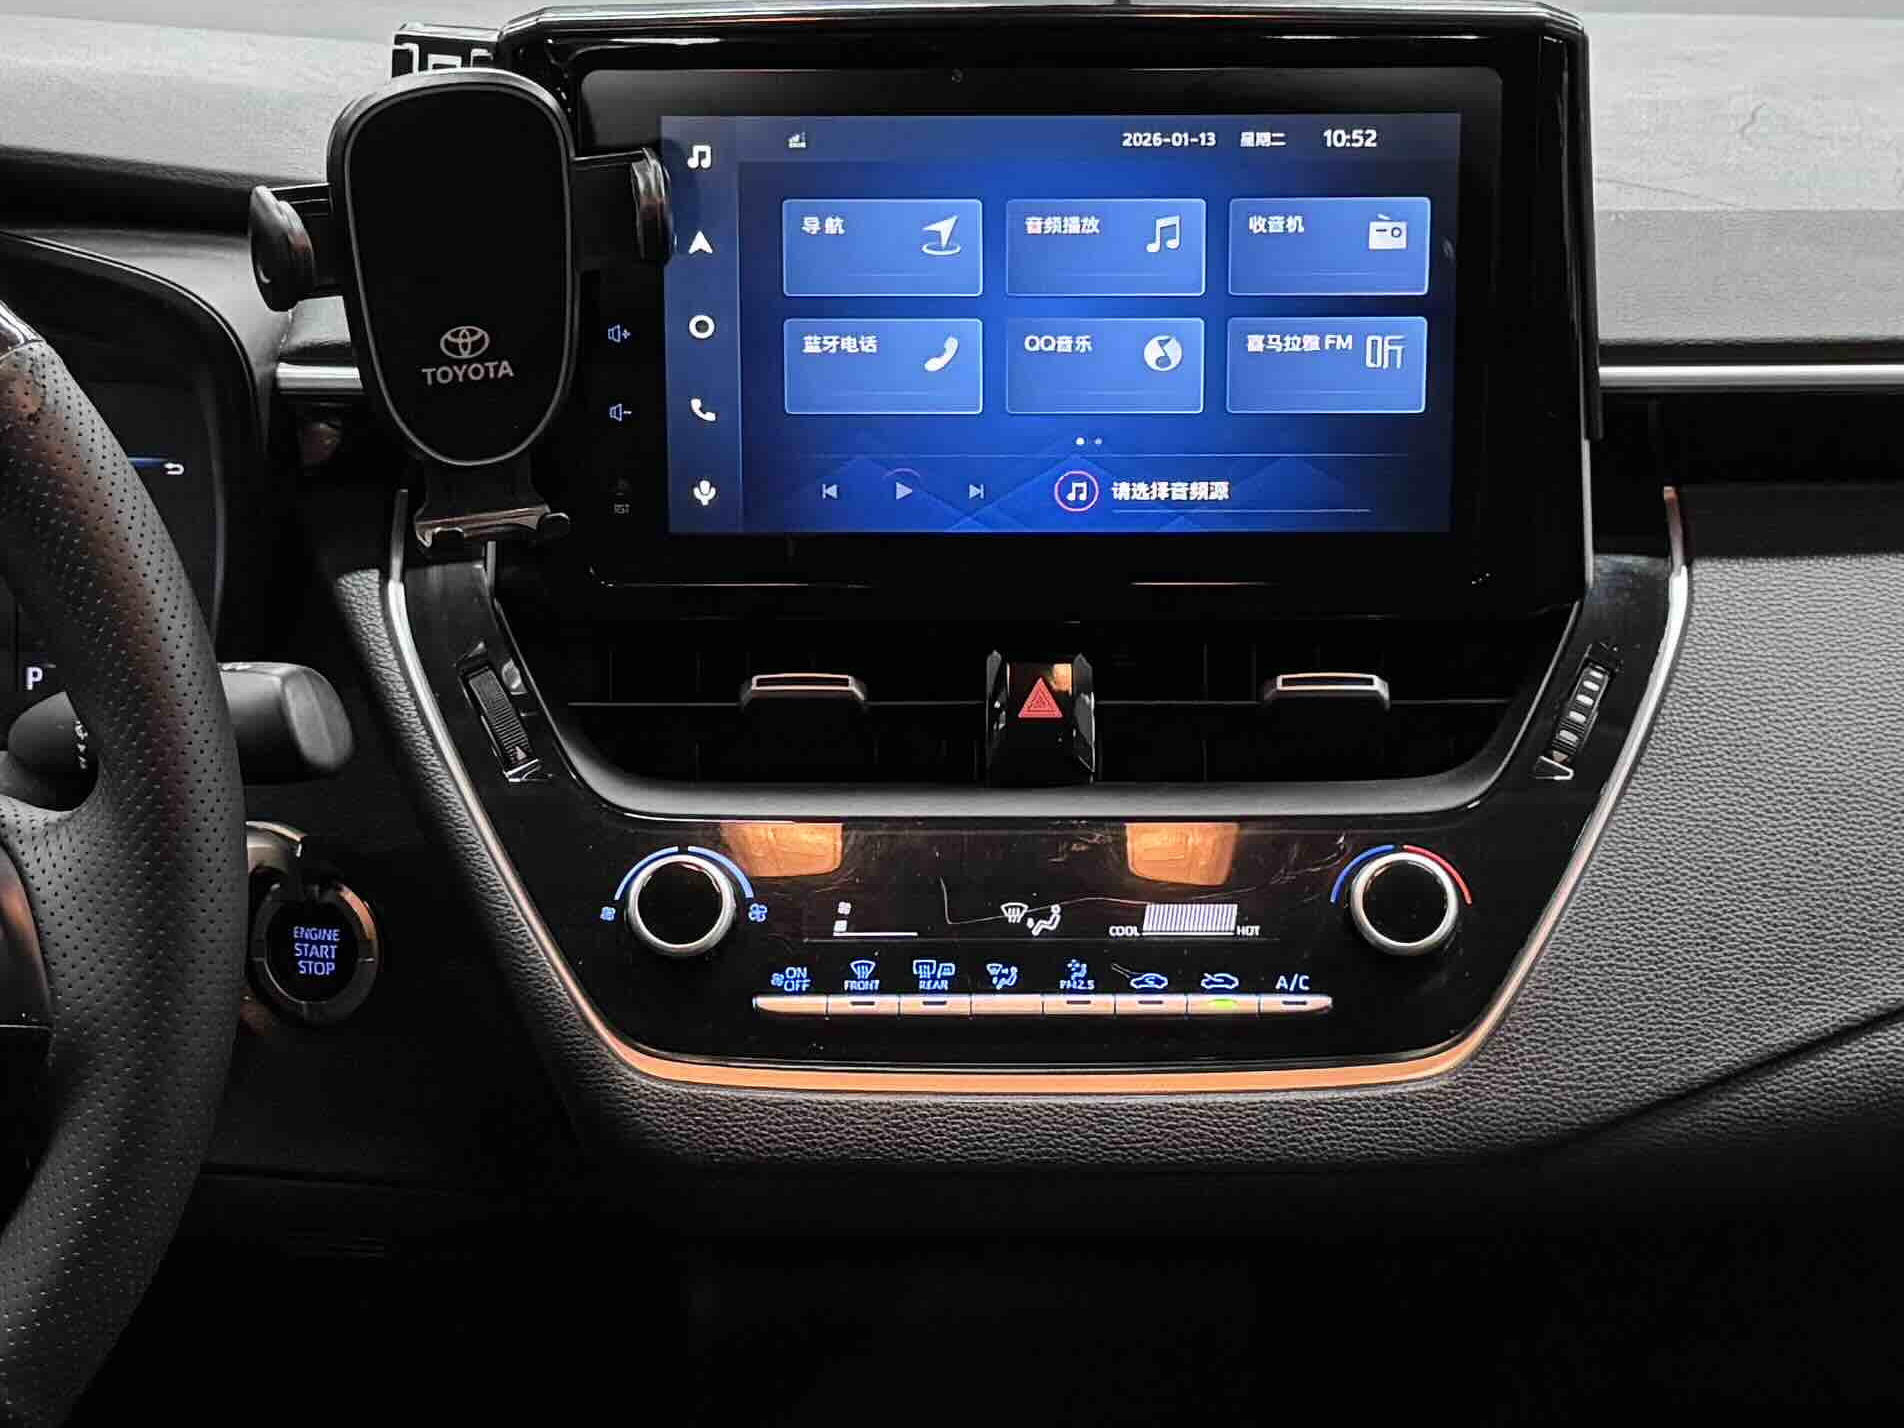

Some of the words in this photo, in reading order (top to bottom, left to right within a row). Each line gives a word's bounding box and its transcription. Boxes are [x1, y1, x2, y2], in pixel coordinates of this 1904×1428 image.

[1122, 131, 1217, 147] 2026-01-13
[1240, 131, 1287, 148] 星期二
[1323, 129, 1378, 148] 10:52
[801, 216, 845, 235] 导航
[1025, 216, 1100, 235] 音频播放
[1248, 215, 1305, 234] 收音机
[803, 335, 878, 354] 蓝牙电话
[1024, 335, 1093, 353] QQ音乐
[1247, 334, 1320, 353] 喜马拉雅
[1325, 334, 1353, 350] FM
[421, 360, 515, 385] TOYOTA
[1111, 481, 1230, 501] 请选择音频源
[25, 666, 43, 690] P
[293, 926, 340, 941] ENGINE
[1108, 925, 1141, 937] COOL
[1236, 925, 1262, 937] HOT
[294, 943, 337, 959] START
[297, 960, 336, 975] STOP
[785, 966, 808, 979] ON
[783, 979, 811, 992] OFF
[844, 979, 880, 991] FRONT
[918, 979, 949, 991] REAR
[1275, 973, 1311, 992] A/C
